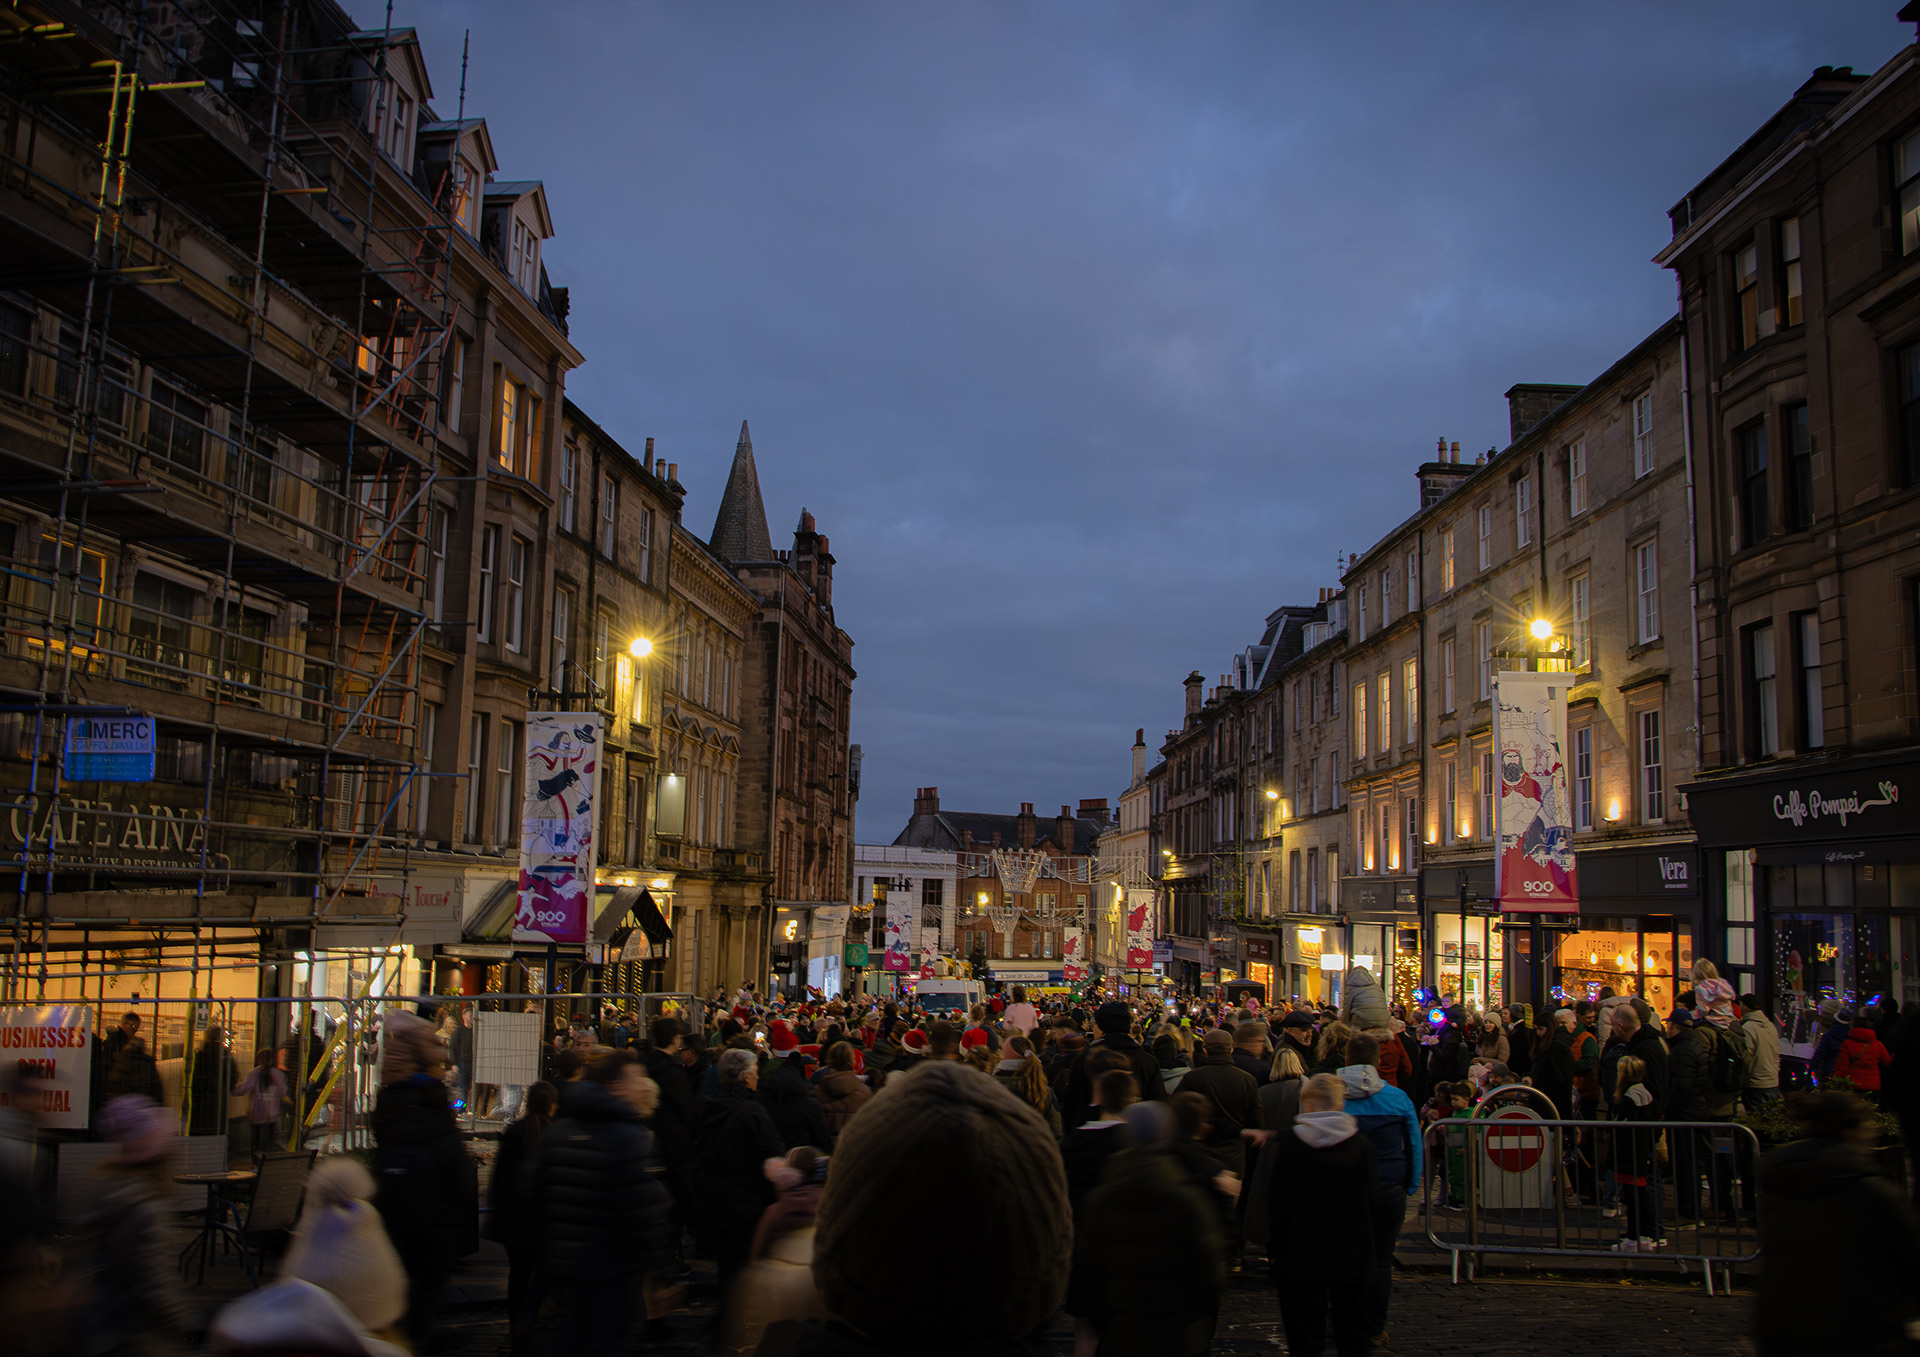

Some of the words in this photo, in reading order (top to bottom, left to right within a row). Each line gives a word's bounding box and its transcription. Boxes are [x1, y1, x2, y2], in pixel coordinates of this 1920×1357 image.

[93, 721, 149, 739] MERC
[1809, 789, 1862, 828] Pompei
[10, 794, 112, 848] CAFE
[118, 803, 211, 854] AINA
[1657, 856, 1688, 880] Vera
[1523, 880, 1554, 893] 900
[537, 910, 567, 922] 900
[1586, 940, 1616, 953] KITCHEN
[0, 1026, 85, 1049] USINESSES
